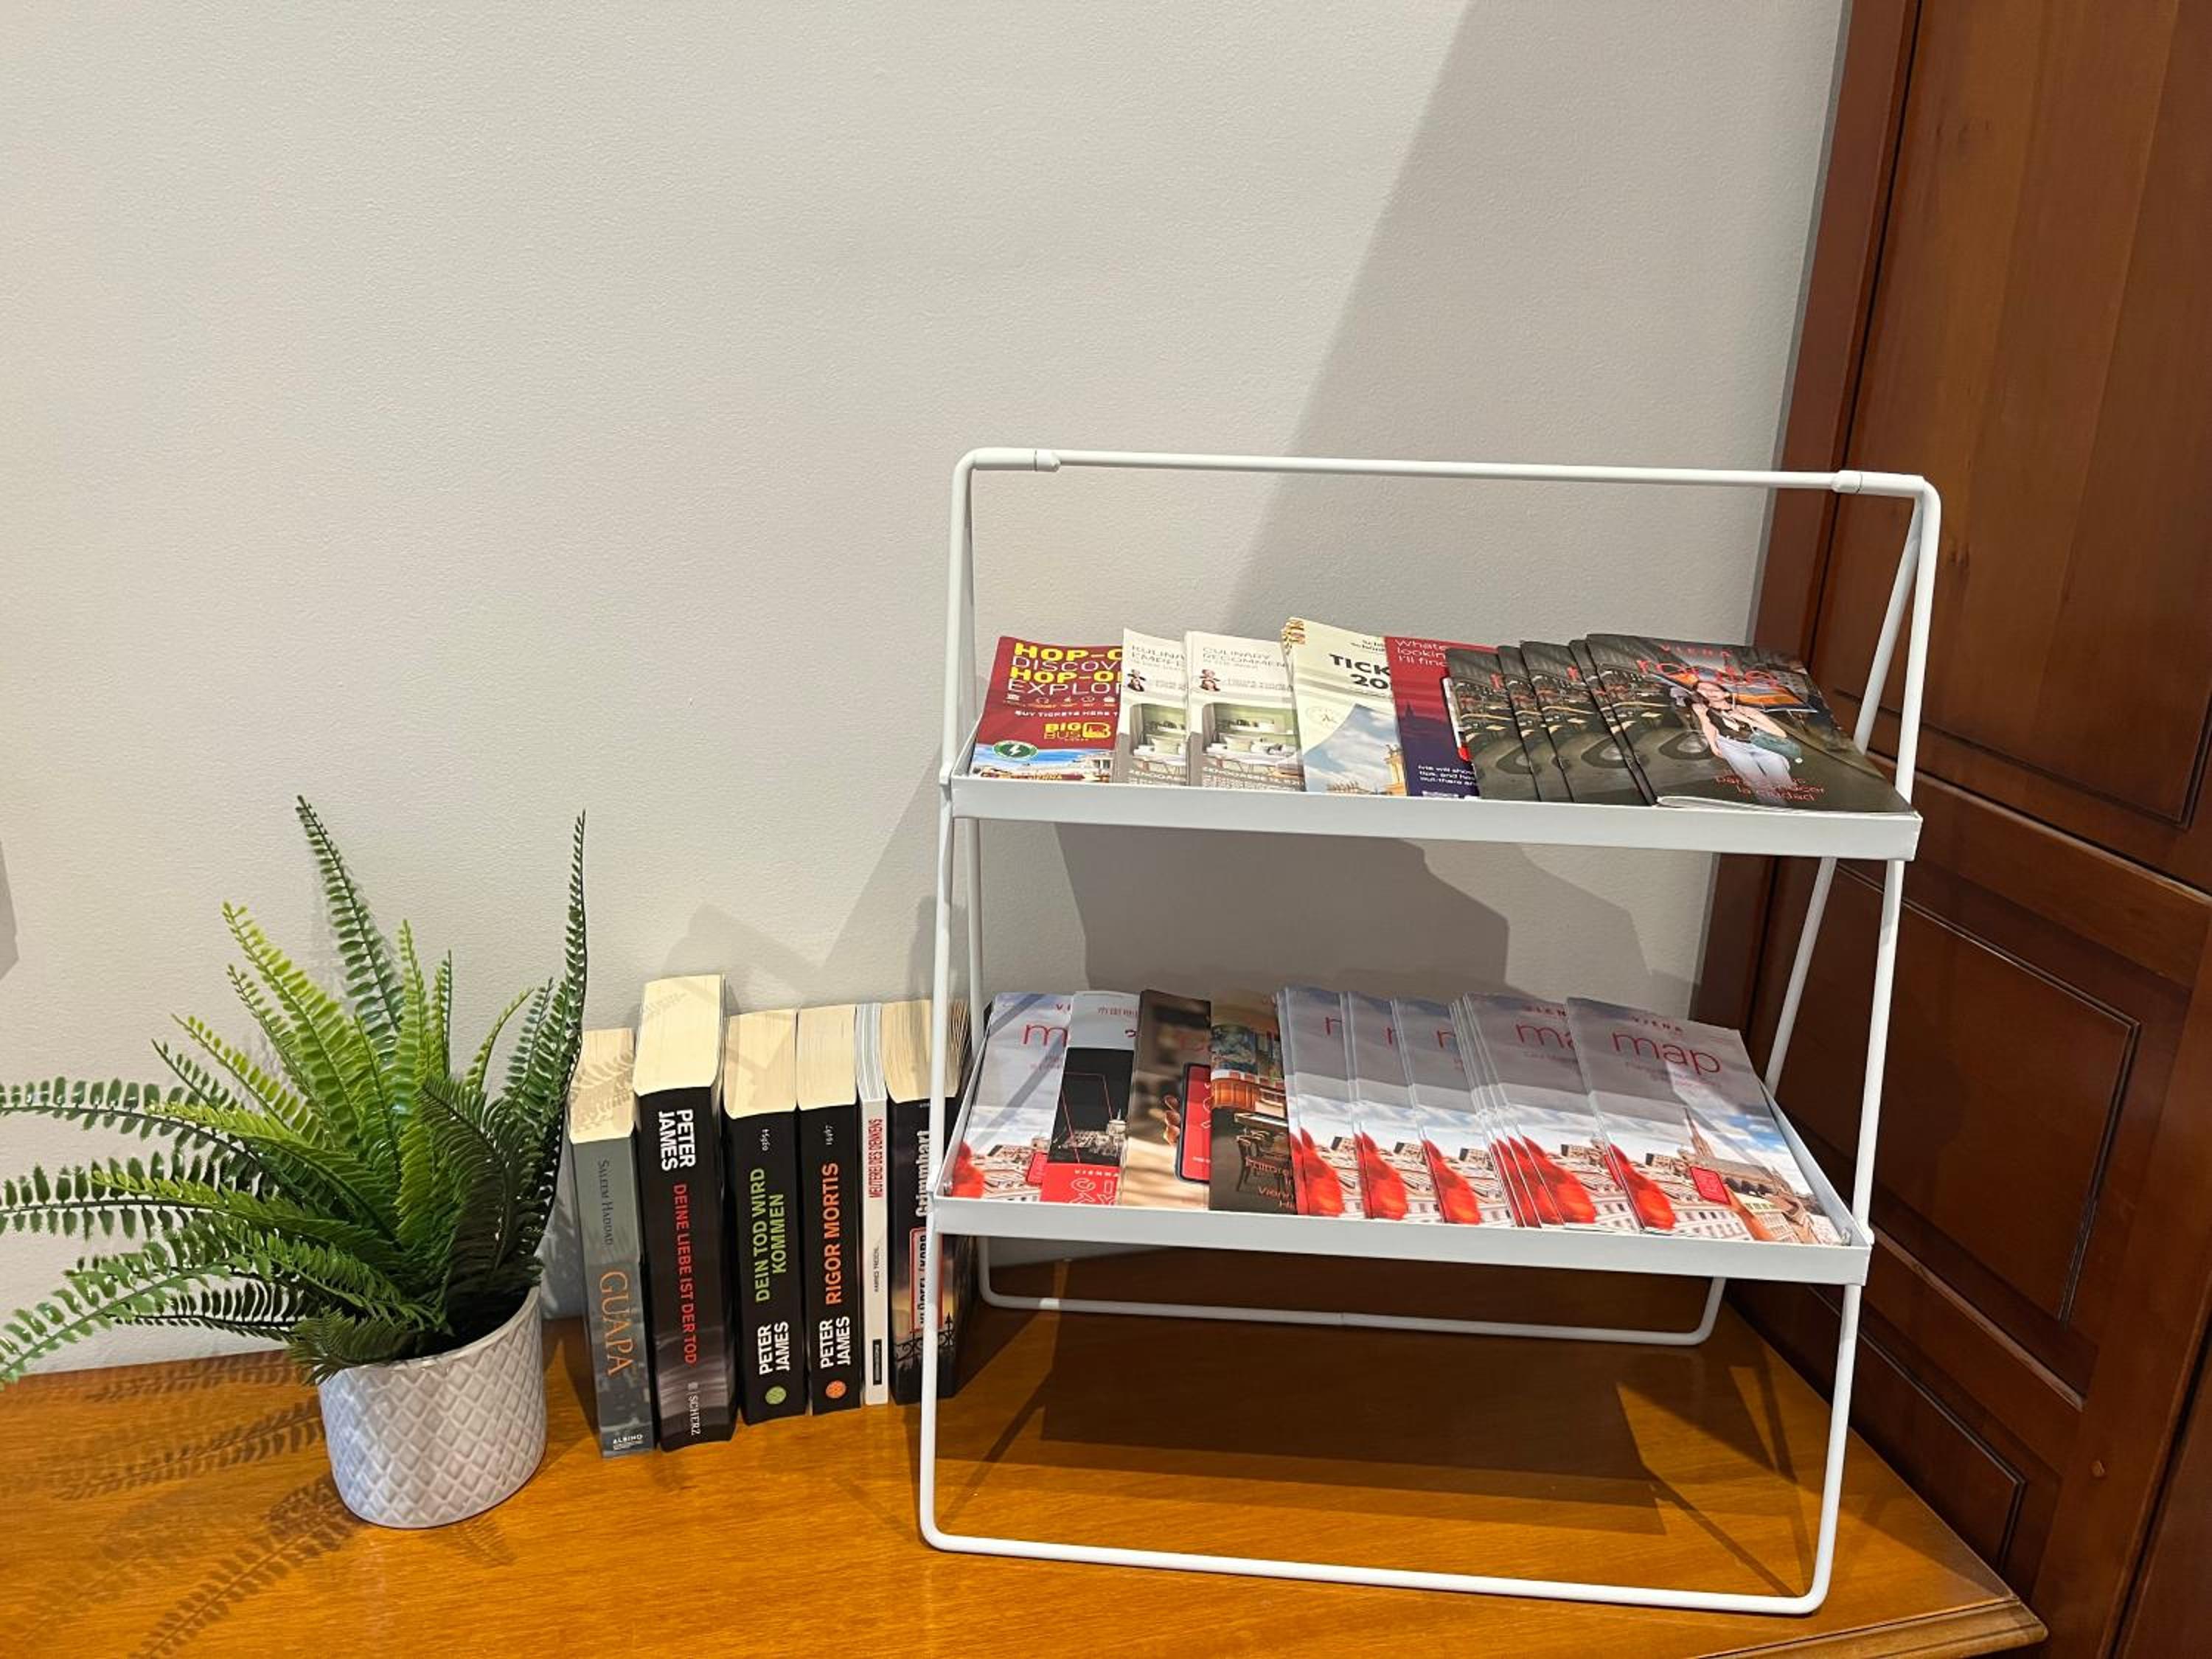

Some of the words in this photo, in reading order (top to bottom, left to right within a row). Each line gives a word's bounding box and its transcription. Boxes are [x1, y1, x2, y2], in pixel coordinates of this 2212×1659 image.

[1012, 655, 1119, 672] DISCOV
[1014, 642, 1122, 661] HOP-O
[1203, 653, 1288, 667] RECOMMEN
[1329, 653, 1391, 676] TICK
[1394, 639, 1450, 651] Whate
[1397, 647, 1446, 661] lookin
[1010, 666, 1121, 684] HOP-O
[1350, 674, 1392, 690] 20
[1045, 722, 1082, 732] BIG
[1612, 1031, 1721, 1075] map
[658, 1110, 678, 1172] JAMES
[676, 1108, 696, 1169] PETER
[673, 1183, 689, 1231] DEINE
[750, 1167, 766, 1218] WIRD
[821, 1163, 840, 1239] MORTIS
[677, 1233, 692, 1276] LIEBE
[752, 1220, 768, 1257] TOD
[769, 1194, 786, 1275] KOMMEN
[680, 1278, 694, 1300] IST
[755, 1259, 771, 1303] DEIN
[824, 1243, 841, 1305] RIGOR
[599, 1270, 634, 1377] GUAPA
[681, 1302, 695, 1333] DER
[684, 1335, 697, 1364] TOD
[757, 1324, 773, 1375] PETER
[773, 1321, 790, 1371] JAMES
[819, 1318, 834, 1369] PETER
[835, 1316, 850, 1366] JAMES
[688, 1394, 701, 1436] SCHERZ
